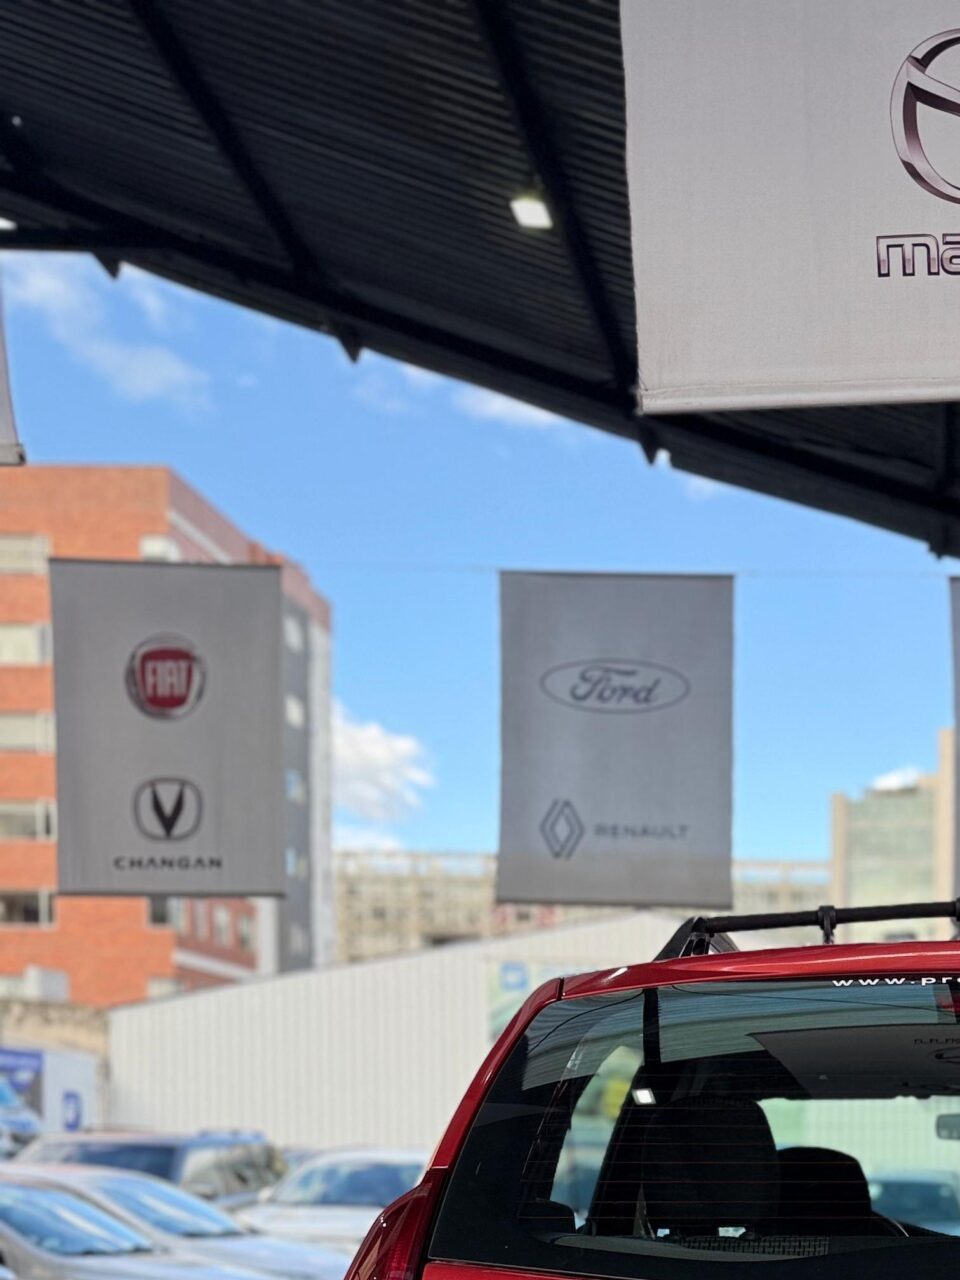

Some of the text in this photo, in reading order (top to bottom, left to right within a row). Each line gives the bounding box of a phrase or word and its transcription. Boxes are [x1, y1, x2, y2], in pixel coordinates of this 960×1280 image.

[144, 658, 191, 698] FIAT
[570, 665, 661, 704] Ford
[593, 824, 690, 840] RENAULT
[113, 856, 223, 871] CHANGAN
